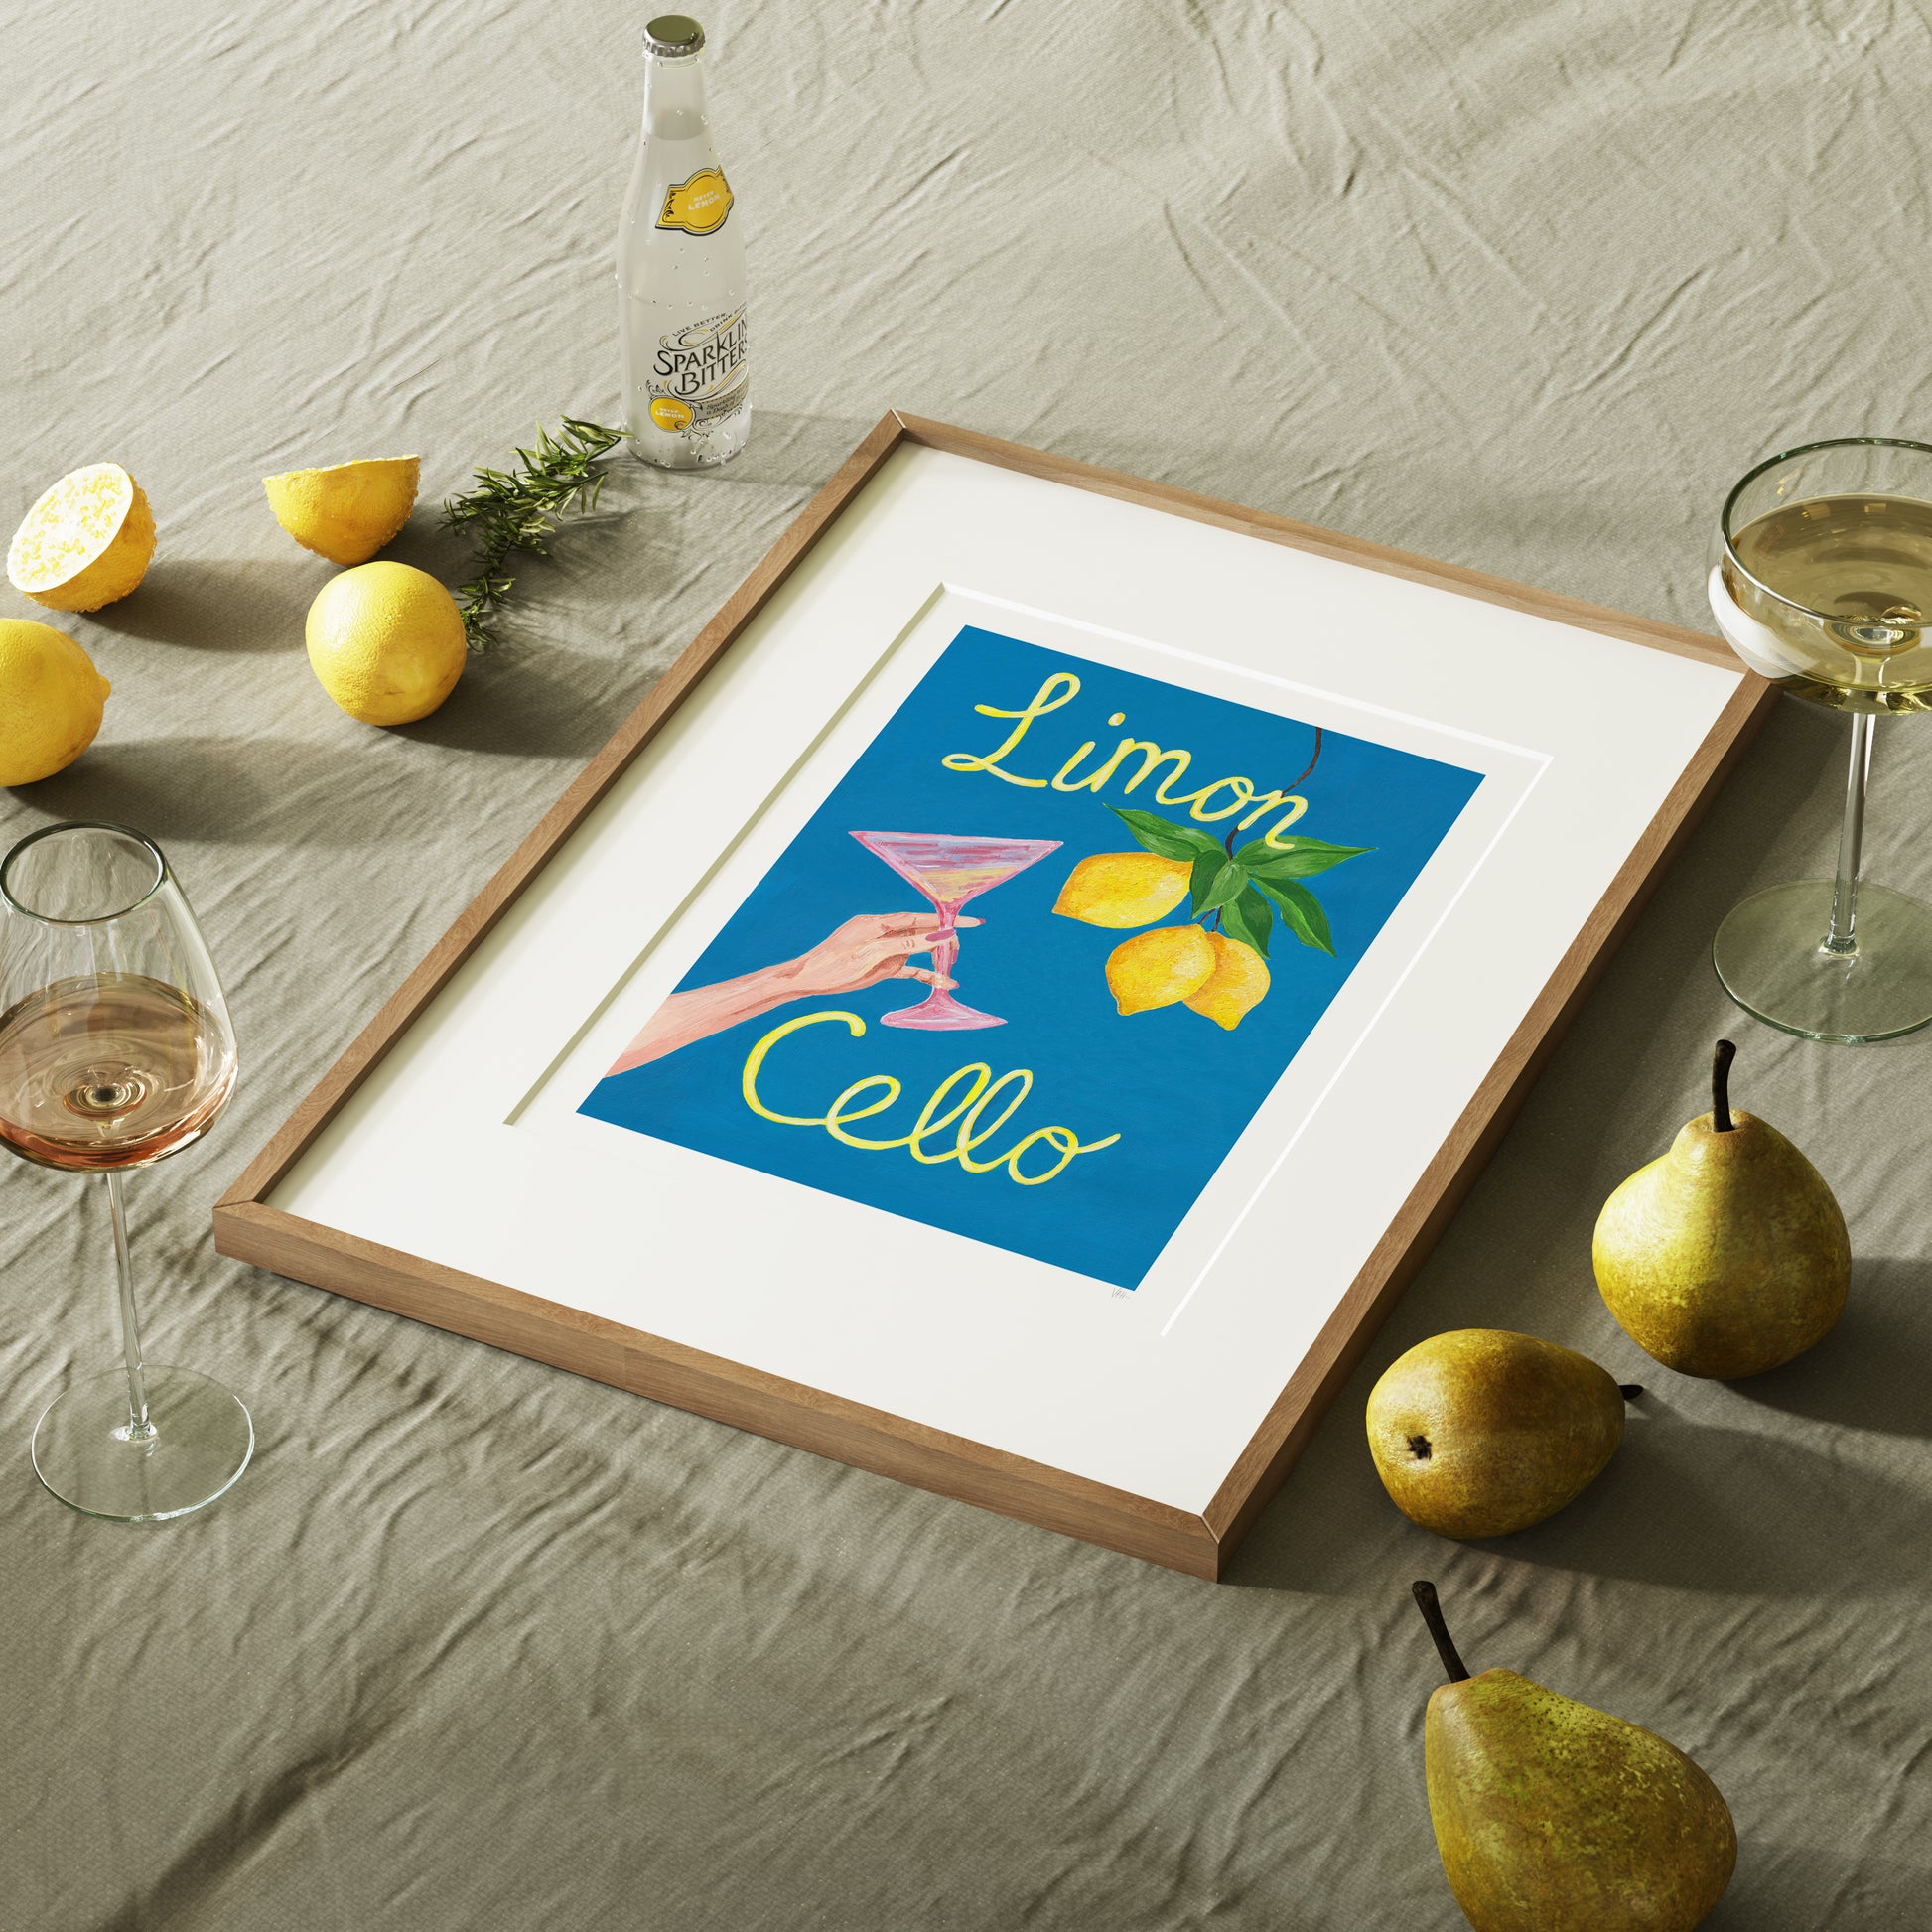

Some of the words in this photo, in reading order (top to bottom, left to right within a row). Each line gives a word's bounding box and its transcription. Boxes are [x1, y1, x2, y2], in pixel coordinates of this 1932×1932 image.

[688, 193, 720, 211] LEMON
[672, 325, 693, 337] LIVE
[710, 314, 733, 332] DRINK
[653, 314, 748, 376] SPARKLIN
[654, 410, 685, 419] LEMON
[941, 672, 1309, 851] Limon
[742, 1011, 1121, 1186] Cello
